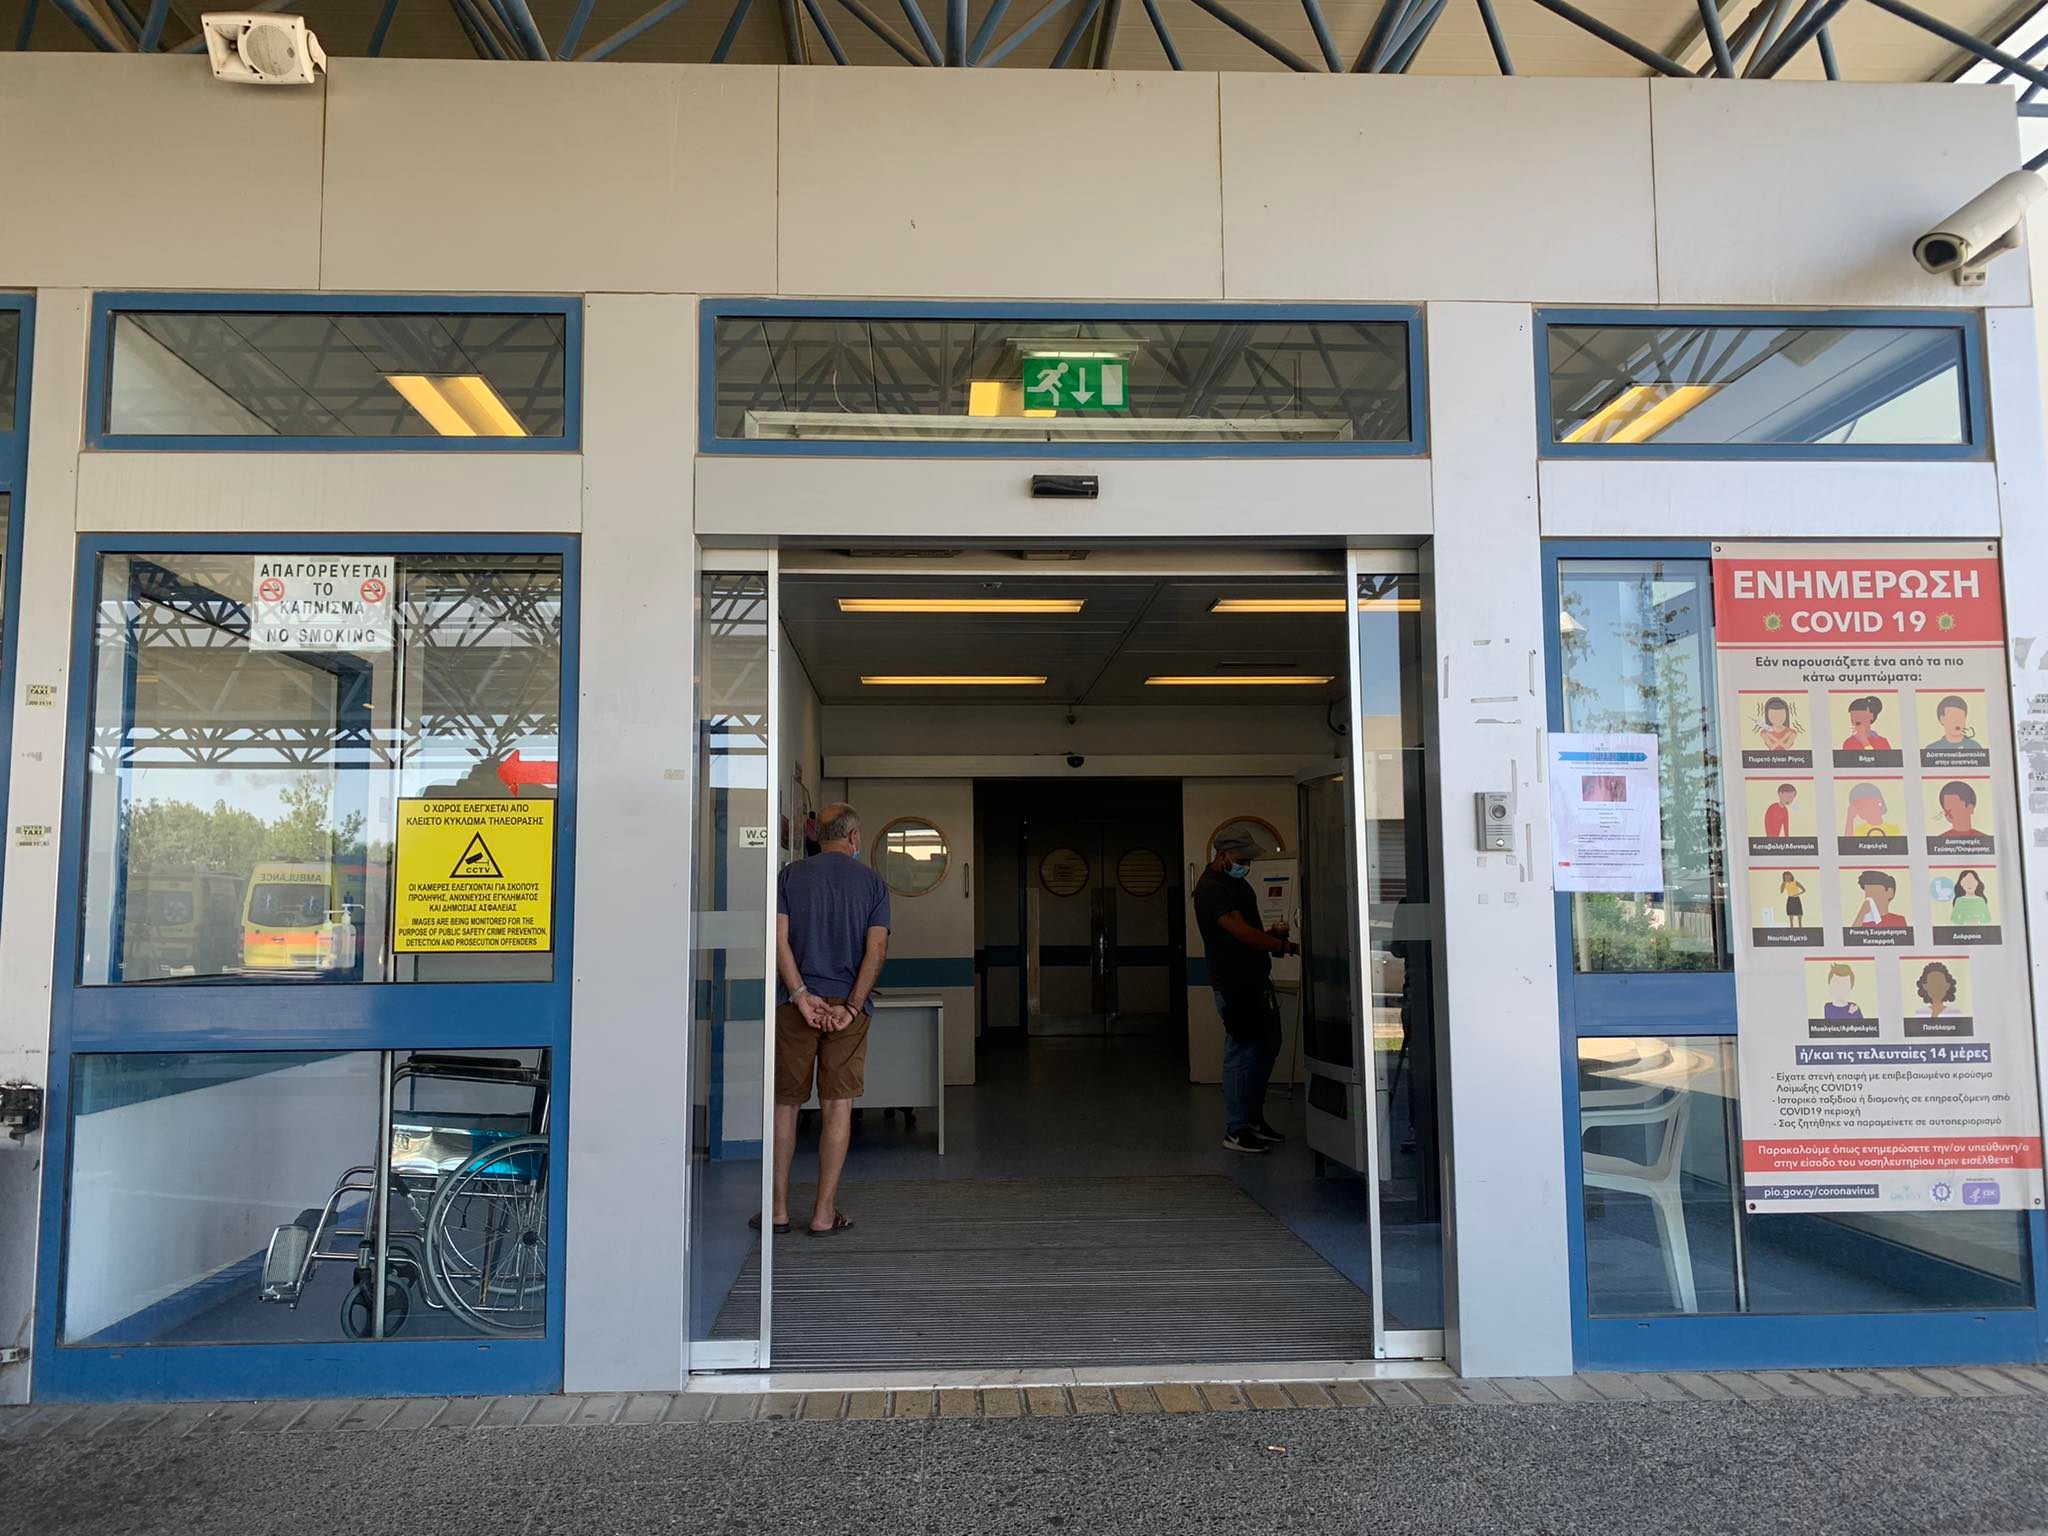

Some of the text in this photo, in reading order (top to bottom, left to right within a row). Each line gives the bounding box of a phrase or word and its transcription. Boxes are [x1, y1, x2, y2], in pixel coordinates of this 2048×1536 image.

[260, 563, 388, 578] ΑΠΑΓΟΡΕΥΕΤΑΙ
[313, 582, 333, 596] ΤΟ
[1733, 569, 1980, 600] ΕΝΗΜΕΡΩΣΗ
[280, 600, 364, 615] ΚΑΠΝΙΣΜΑ
[1790, 610, 1927, 633] COVID 19
[266, 628, 376, 643] NO SMOKING
[1755, 655, 1964, 670] Εάν παρουσιάζετε ένα από τα πιο
[1802, 671, 1922, 684] κάτω συμπτώματα:
[424, 804, 529, 813] Ο ΧΩΡΟΣ ΕΛΕΓΧΕΤΑΙ ΑΠΟ
[406, 816, 544, 826] ΚΛΕΙΣΤΟ ΚΥΚΛΩΜΑ ΤΗΛΕΟΡΑΣΗΣ
[408, 883, 539, 891] ΟΙ ΚΑΜΕΡΕΣ ΕΛΕΓΧΟΝΤΑΙ ΓΙΑ ΣΚΟΠΟΥΣ
[449, 893, 492, 901] ΑΝΙΧΝΕΥΣΗΣ
[493, 893, 538, 901] ΕΓΚΛΗΜΑΤΟΣ
[429, 903, 517, 912] ΚΑΙ ΔΗΜΟΣΙΑΣ ΑΣΦΑΛΕΙΑΣ
[471, 917, 507, 925] MONITORED
[508, 917, 521, 925] FOR
[522, 917, 534, 925] THE
[398, 928, 428, 936] PURPOSE
[429, 928, 438, 936] OF
[438, 928, 461, 936] PUBLIC
[487, 928, 506, 936] CRIME
[507, 928, 548, 936] PREVENTION,
[405, 938, 538, 947] DETECTION AND PROSECUTION OFFENDERS
[1800, 1046, 1988, 1063] ή/και τις τελευταίες 14 μέρες
[1776, 1070, 1993, 1082] Είχατε στενή επαφή με επιβεβαιωμένο κρούσμα
[1776, 1083, 1863, 1094] Λοίμωξης COVID19
[1777, 1095, 1817, 1105] Ιστορικό
[1819, 1095, 1857, 1105] ταξιδιού
[1867, 1094, 1909, 1105] διαμονής
[1911, 1095, 1922, 1103] σε
[1924, 1093, 1990, 1104] επηρεαζόμενη
[1991, 1093, 2011, 1102] από
[1779, 1107, 1861, 1117] COVID19 περιοχή
[1778, 1119, 1796, 1128] Σας
[1798, 1118, 1843, 1129] ζητήθηκε
[1856, 1117, 1913, 1128] παραμείνετε
[1929, 1116, 2002, 1127] αυτοπεριορισμό
[1758, 1142, 2030, 1157] Παρακαλούμε όπως ενημερώσετε την/ον υπεύθυνη/ο
[1774, 1155, 2014, 1169] στην είσοδο του νοσηλευτηρίου πριν εισέλθετε!
[1764, 1185, 1875, 1199] pio.gov.cy/coronavirus
